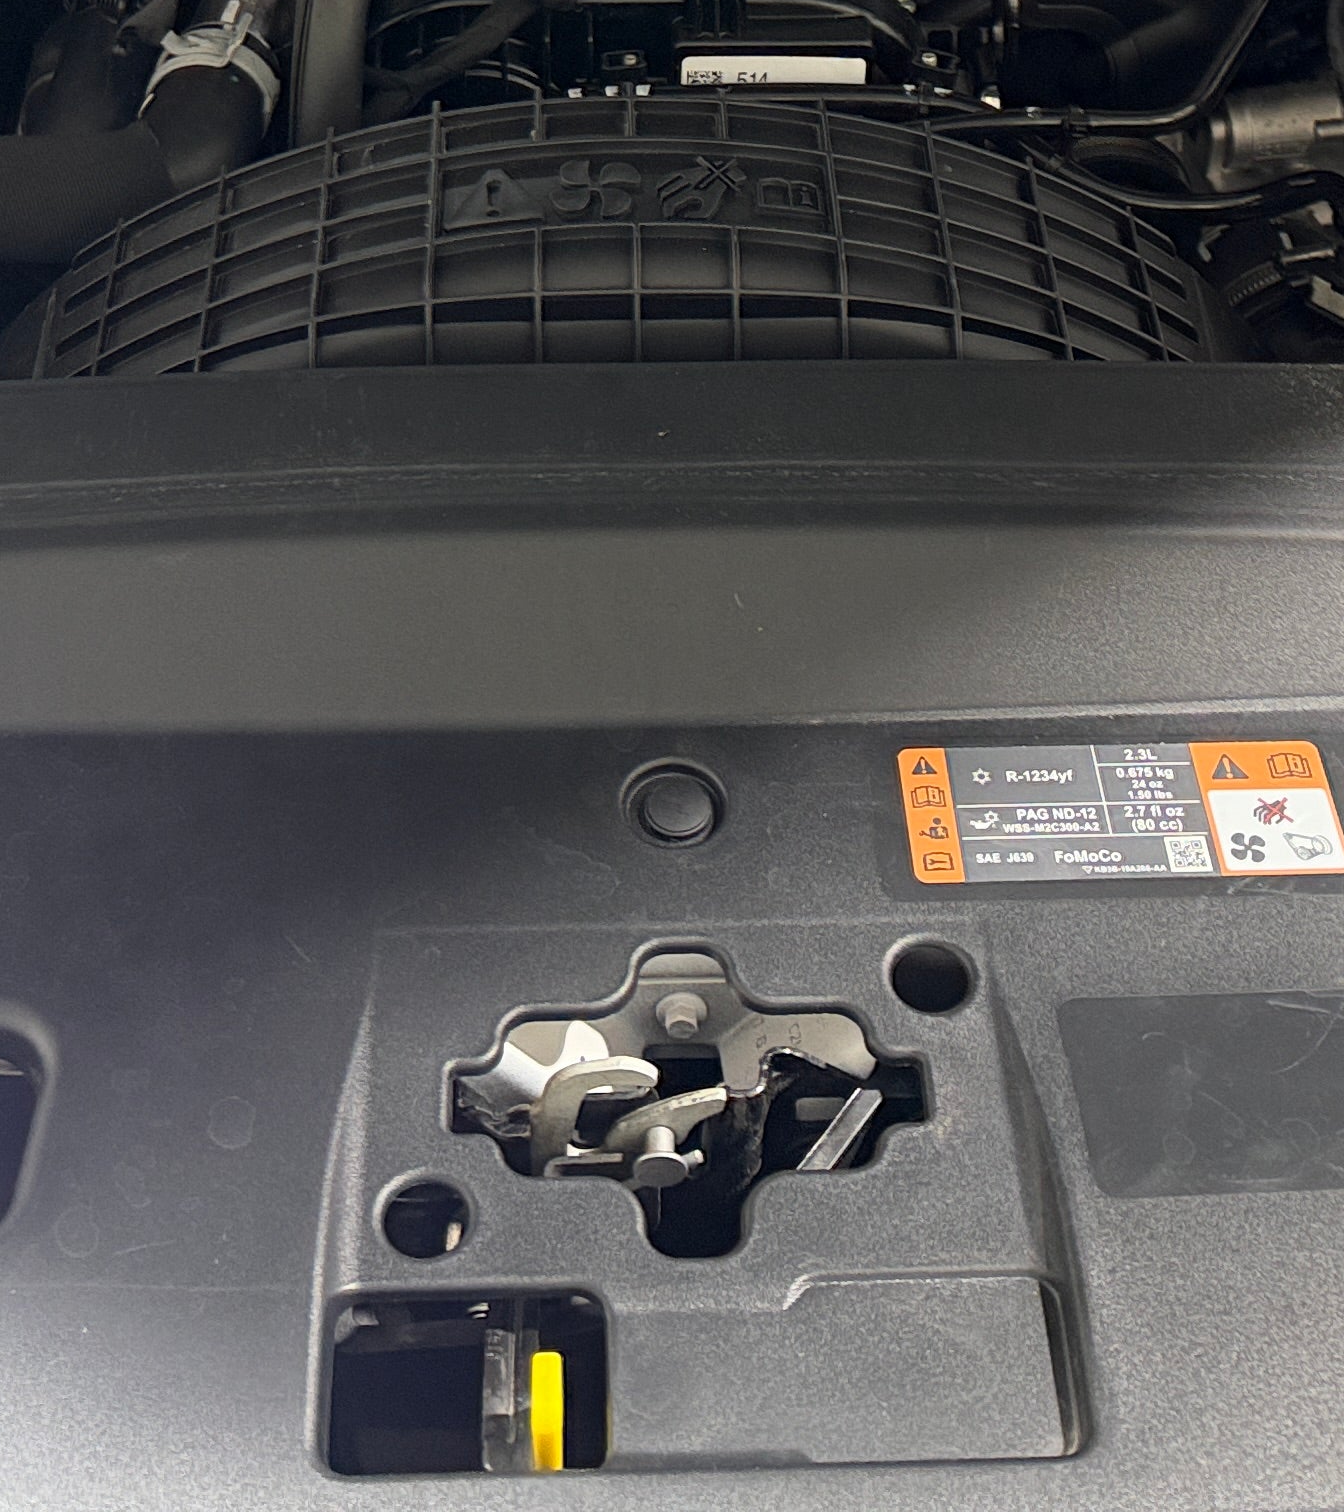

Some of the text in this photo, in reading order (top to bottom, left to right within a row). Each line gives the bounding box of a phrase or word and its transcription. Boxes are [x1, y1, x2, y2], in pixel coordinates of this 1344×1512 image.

[1123, 748, 1158, 761] 2.3L
[1005, 769, 1073, 784] R-1234yf
[1115, 767, 1175, 780] 0.675 kg
[1131, 779, 1164, 789] 24 oz
[1153, 790, 1174, 800] lbs
[1016, 807, 1098, 821] PAG ND-12
[1123, 804, 1185, 818] 2.7 fl oz
[1131, 818, 1184, 833] (80 cc)
[975, 851, 1035, 864] SAE J639
[1053, 848, 1123, 864] FoMoCo
